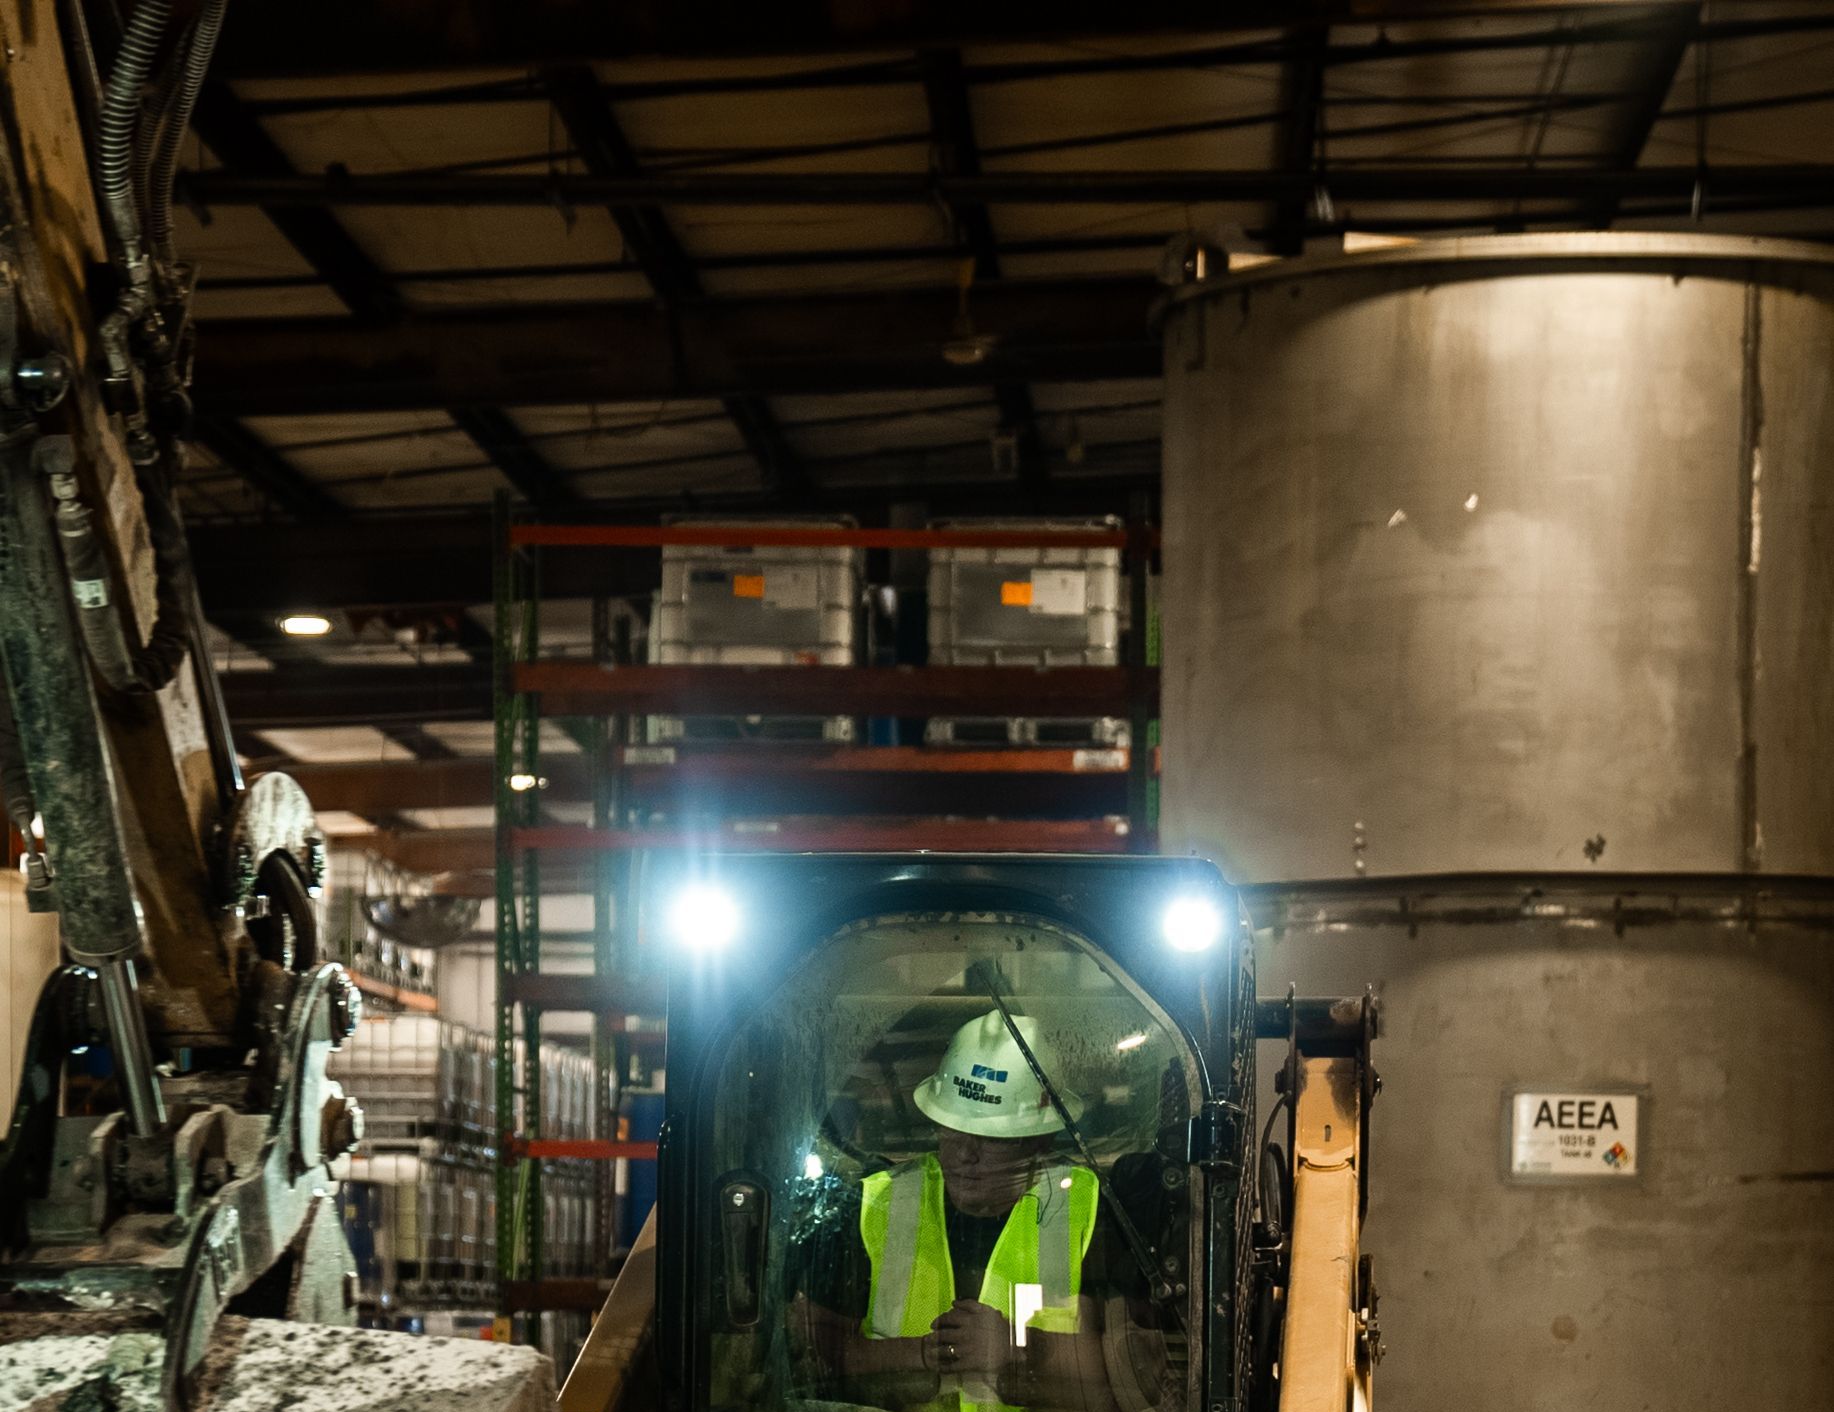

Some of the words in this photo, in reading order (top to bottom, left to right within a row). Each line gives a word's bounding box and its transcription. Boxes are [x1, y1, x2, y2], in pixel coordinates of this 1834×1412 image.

[953, 1076, 986, 1093] BAKER
[958, 1087, 1002, 1105] HUGHES
[1534, 1100, 1619, 1130] AEEA
